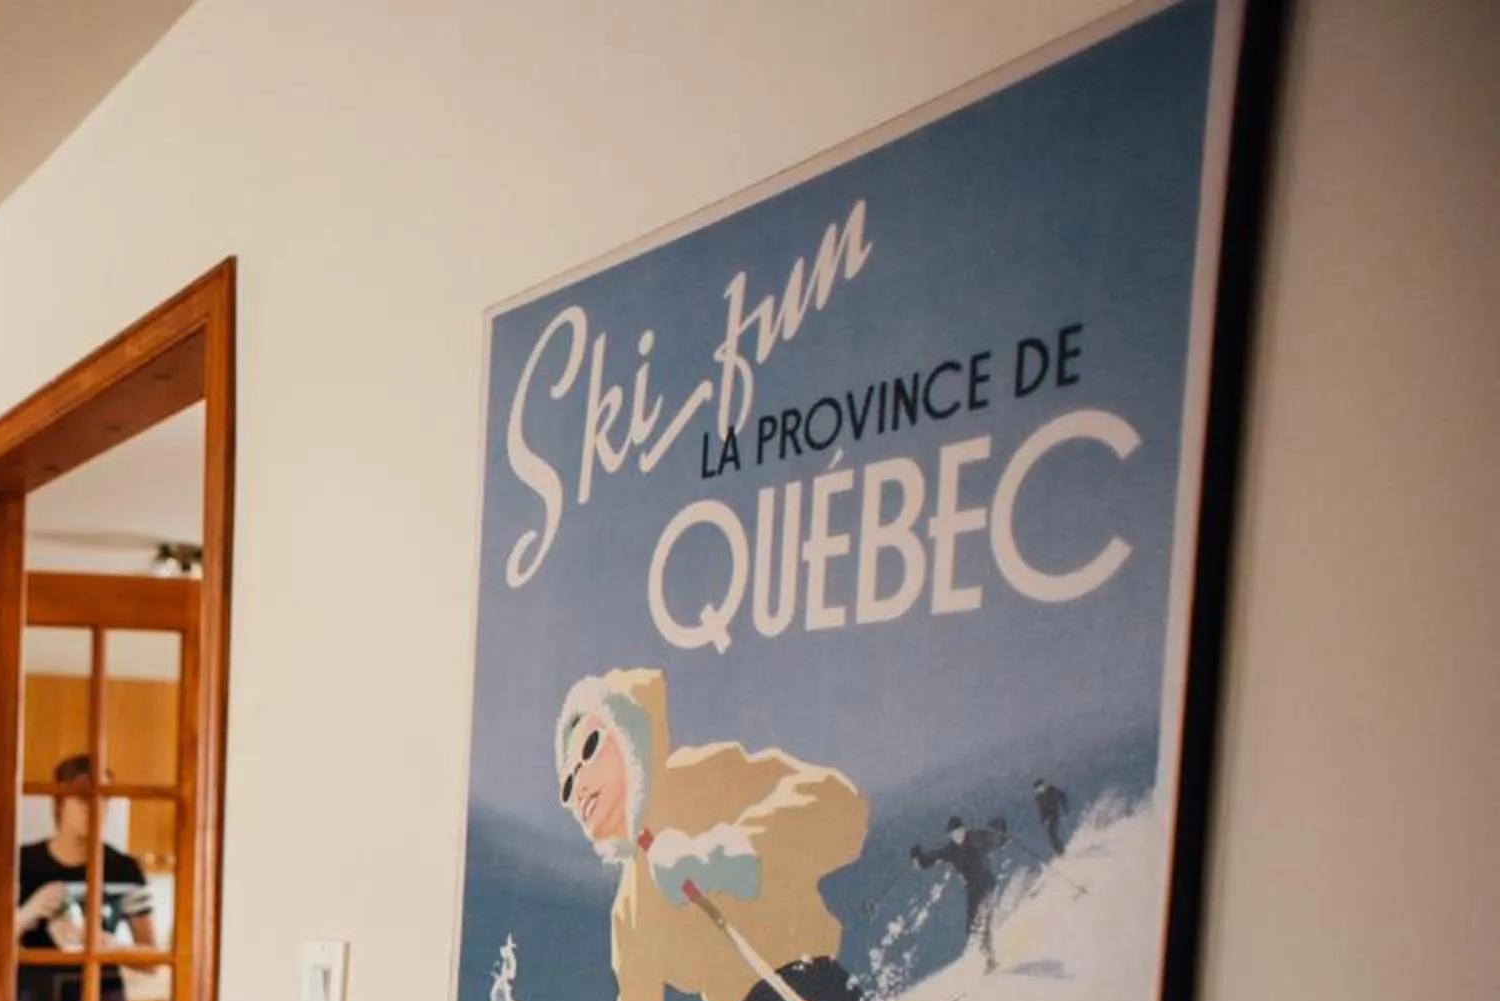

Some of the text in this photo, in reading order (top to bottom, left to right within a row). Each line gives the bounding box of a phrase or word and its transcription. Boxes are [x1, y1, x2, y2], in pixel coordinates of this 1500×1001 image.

[701, 324, 1083, 479] LA PROVINCE DE
[647, 409, 1141, 655] QUÉBEC
